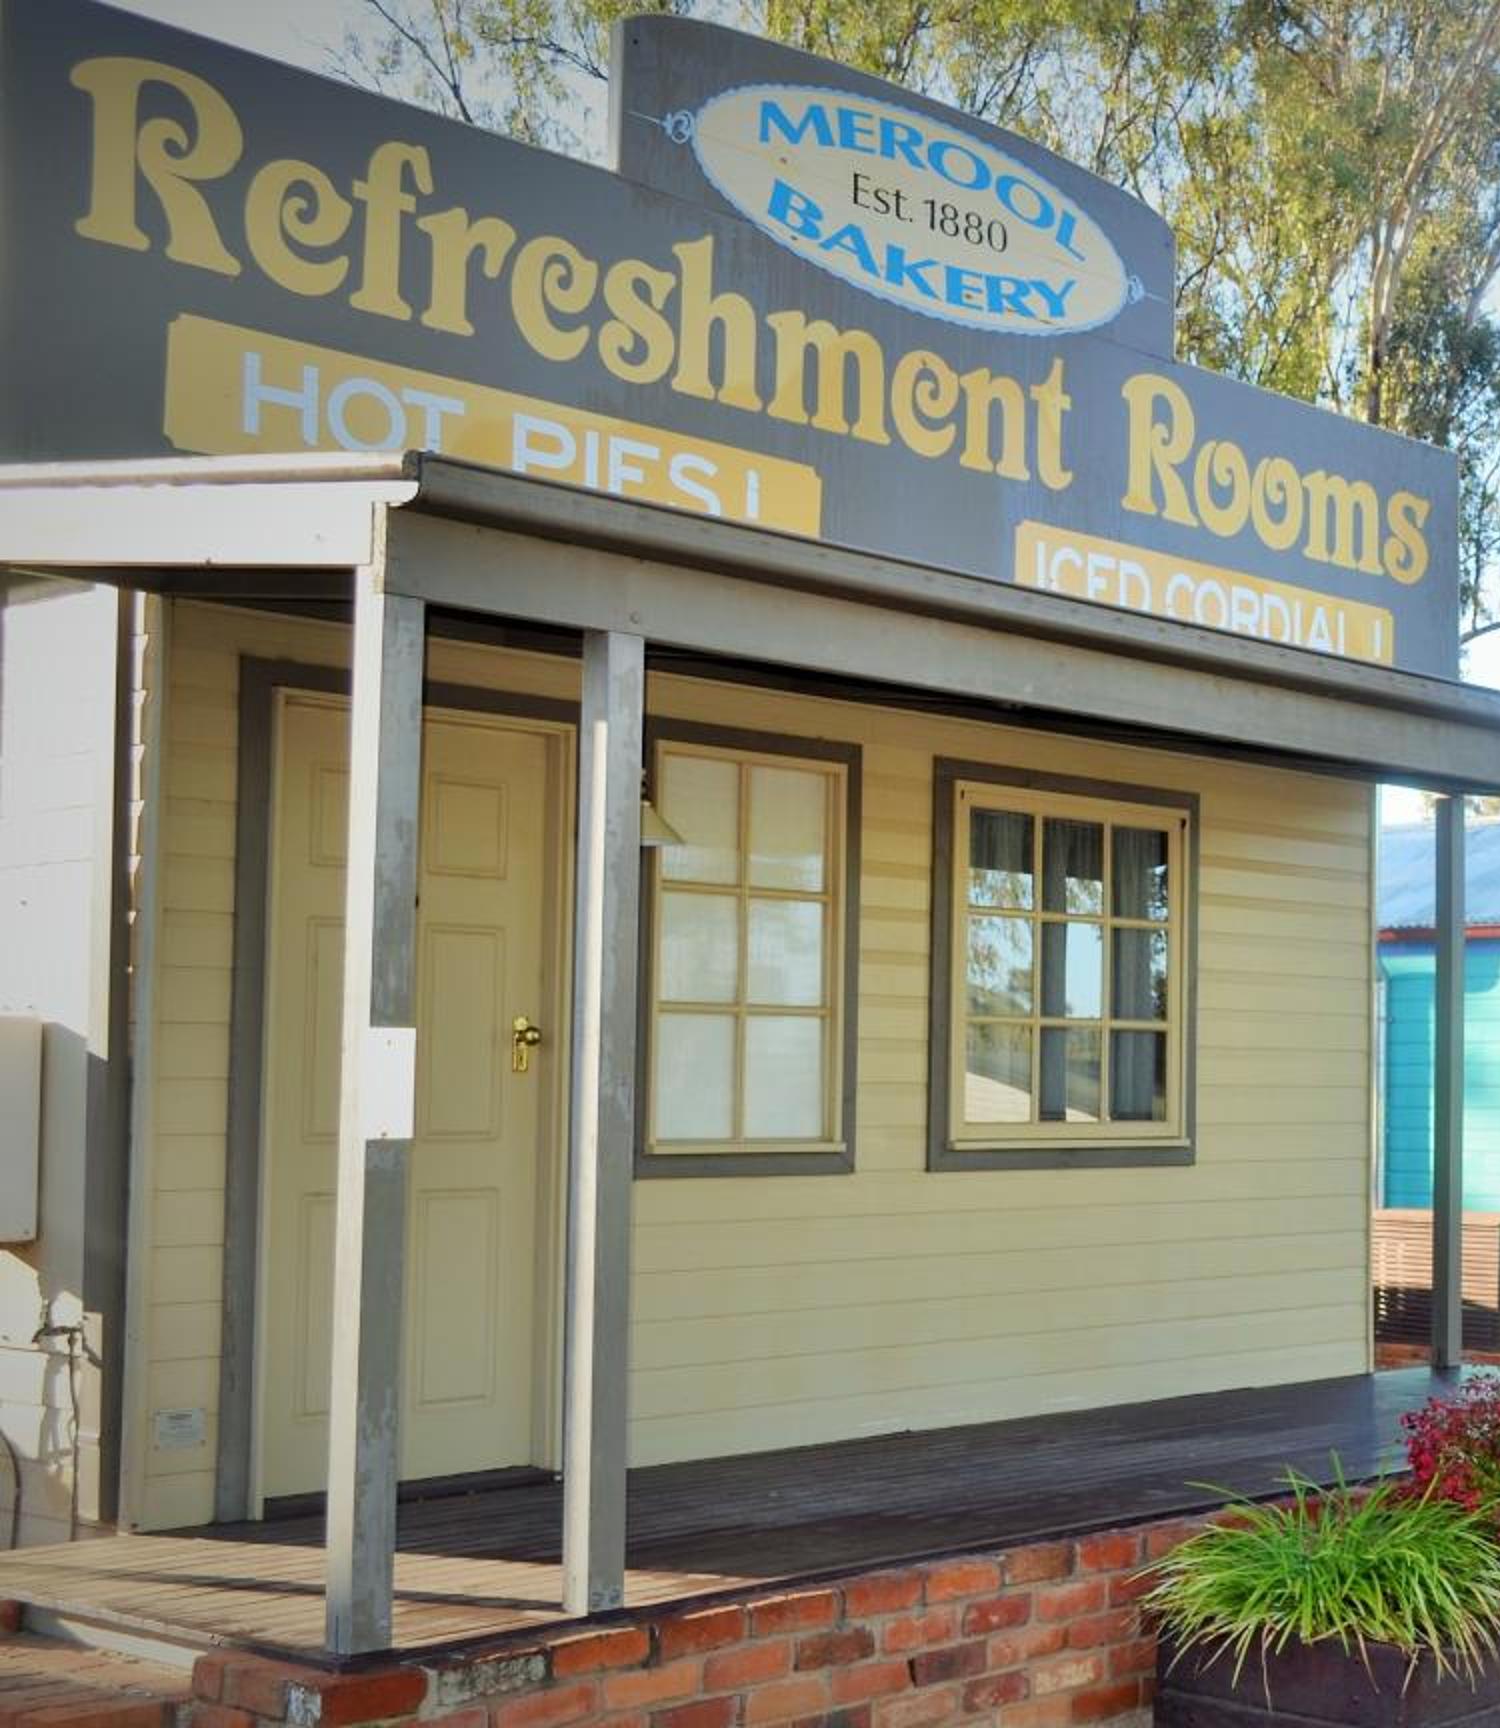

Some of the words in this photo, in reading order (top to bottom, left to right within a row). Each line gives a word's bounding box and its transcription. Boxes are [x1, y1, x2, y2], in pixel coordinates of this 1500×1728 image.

[758, 100, 1086, 262] MEROOL
[853, 172, 913, 223] Est.
[922, 199, 1008, 254] 1880
[767, 178, 1077, 326] BAKERY
[68, 56, 1073, 492] Refreshment
[1120, 372, 1432, 585] Rooms
[243, 350, 466, 454] HOT
[1035, 542, 1150, 613] ICED
